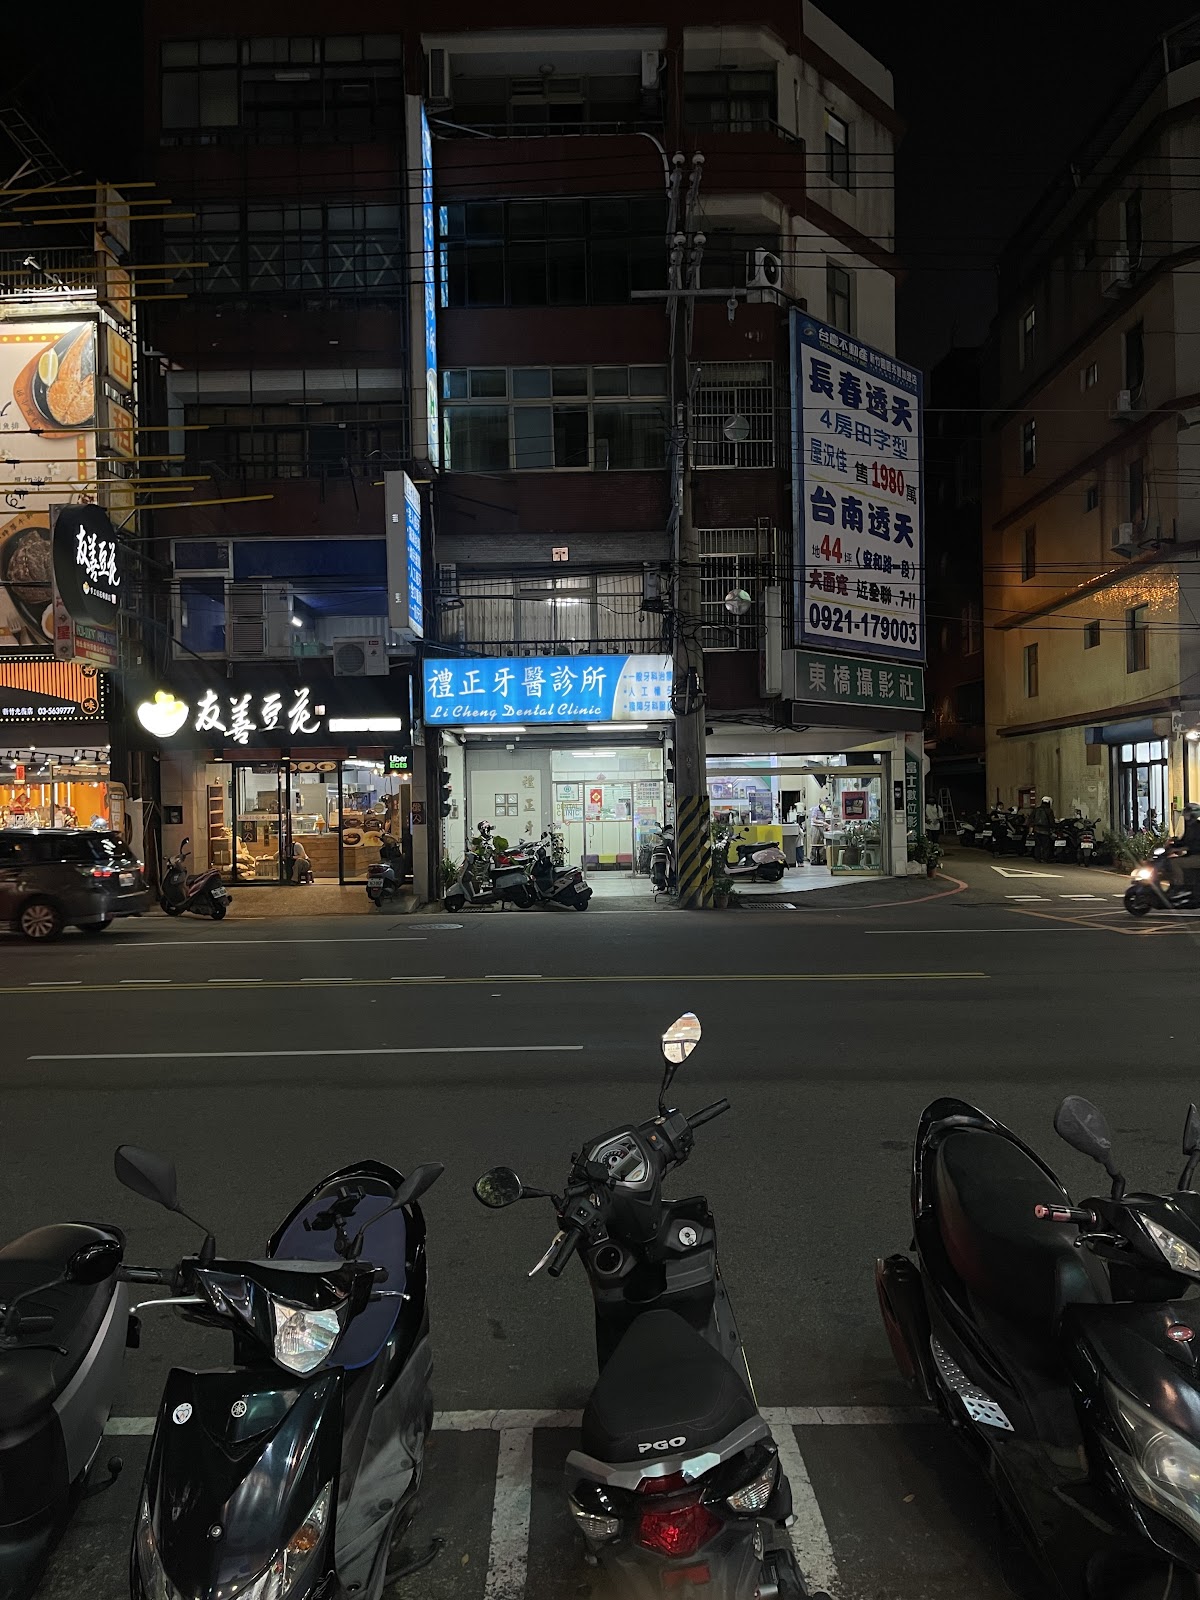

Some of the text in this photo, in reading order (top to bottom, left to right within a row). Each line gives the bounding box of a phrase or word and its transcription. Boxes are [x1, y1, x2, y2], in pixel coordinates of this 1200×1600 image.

[809, 357, 913, 433] 長春透天
[820, 410, 908, 461] 4房田字型
[810, 485, 913, 548] 台南透天
[76, 524, 120, 587] 友善豆花
[809, 603, 917, 644] 0921-179003
[427, 665, 607, 698] 禮正牙醫診所
[808, 661, 915, 702] 東橋攝影社
[37, 706, 76, 716] 03-5639777
[195, 687, 321, 745] 友善豆花
[430, 702, 602, 720] Li Cheng Dental Clinic
[389, 754, 407, 762] Uber
[637, 1436, 687, 1454] PGO
